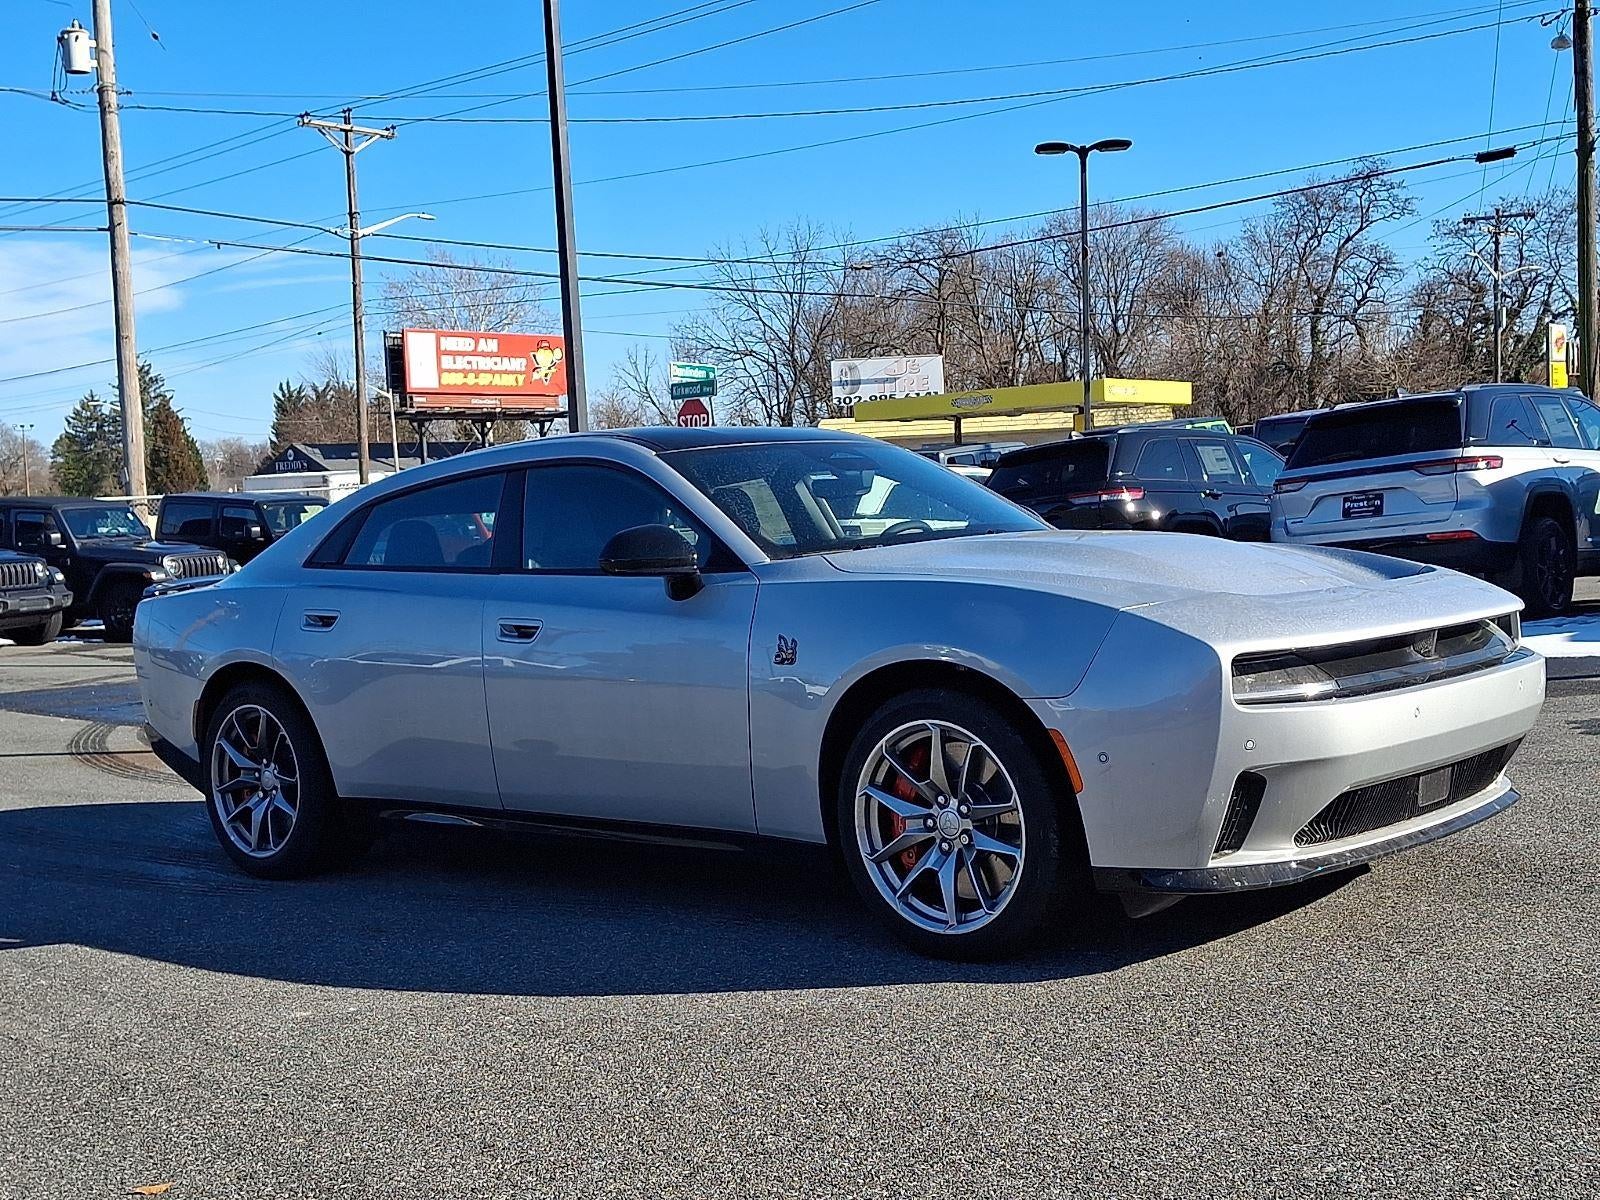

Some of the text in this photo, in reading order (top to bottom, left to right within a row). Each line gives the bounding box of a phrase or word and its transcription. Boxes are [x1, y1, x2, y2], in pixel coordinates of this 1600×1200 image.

[440, 337, 498, 353] NEED AN
[441, 356, 527, 371] ELECTRICIAN?
[673, 384, 700, 396] Kirkwood
[874, 375, 930, 393] TIRE
[679, 414, 707, 427] STOP
[275, 461, 308, 471] FREDDY'S
